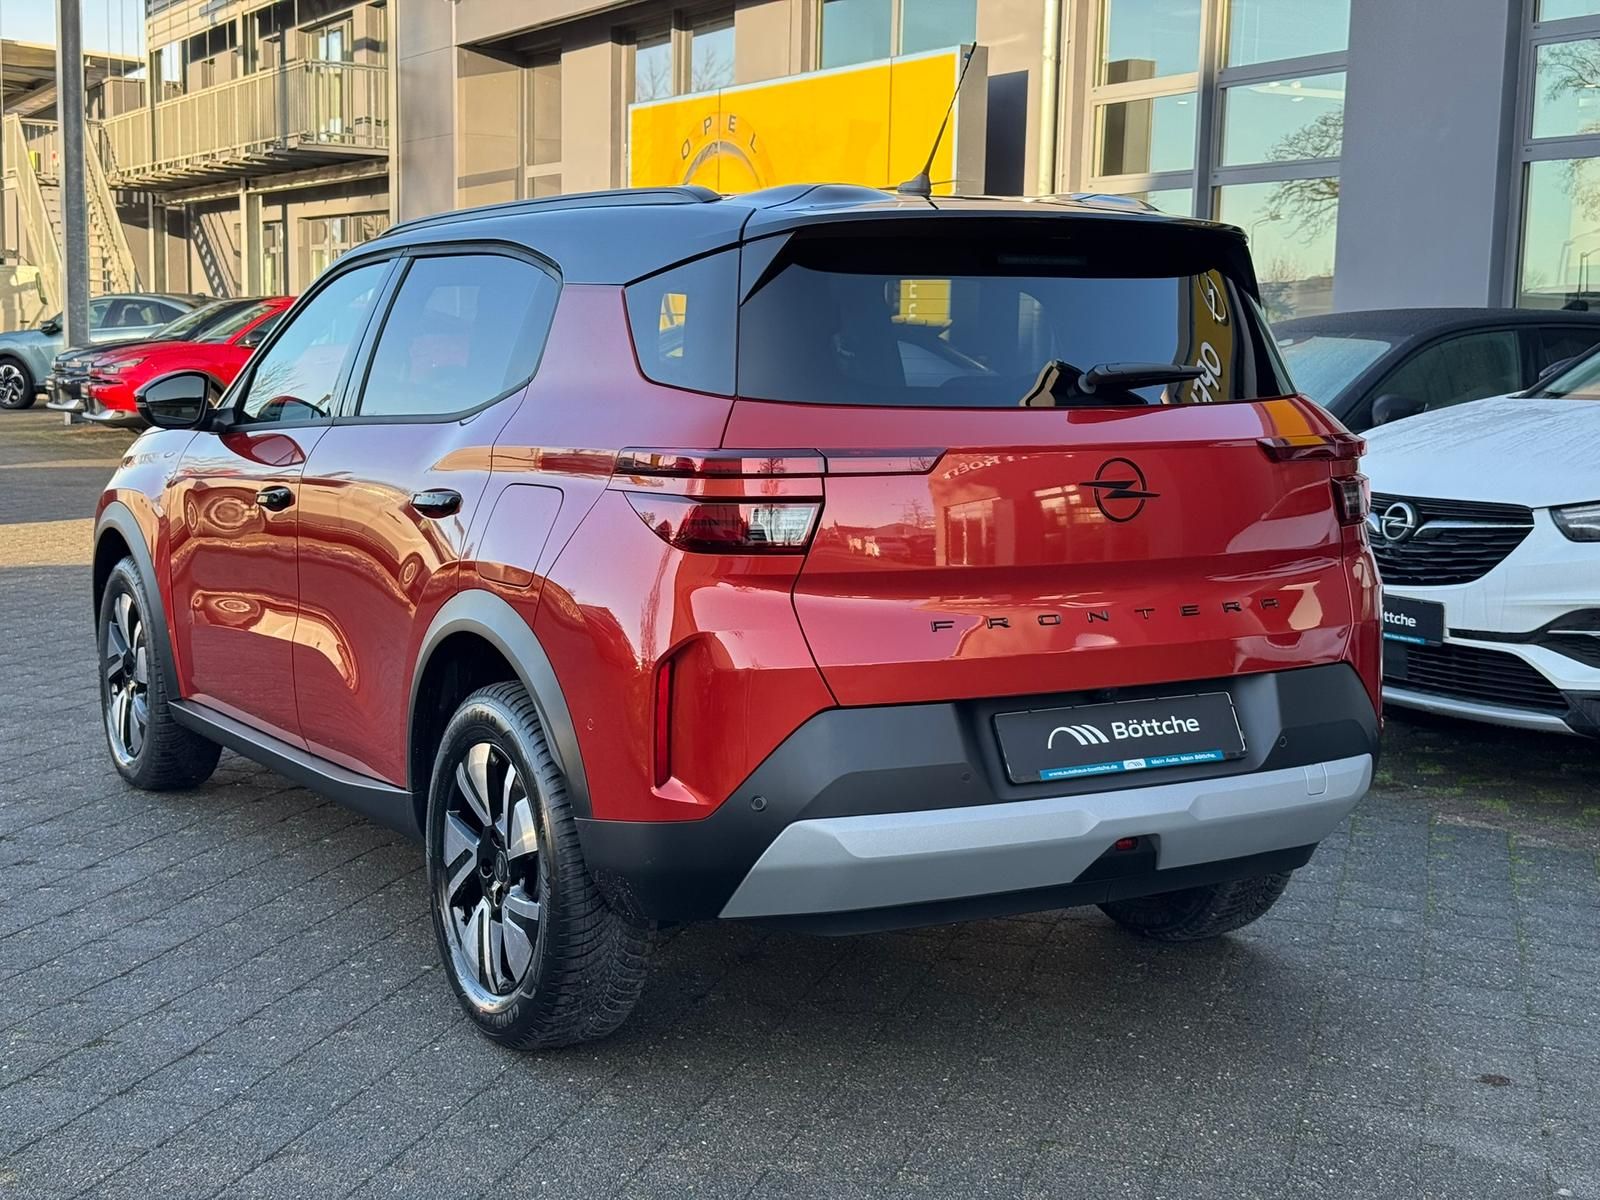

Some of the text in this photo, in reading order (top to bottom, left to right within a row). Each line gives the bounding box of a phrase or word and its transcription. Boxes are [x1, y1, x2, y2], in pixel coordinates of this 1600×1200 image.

[681, 114, 757, 160] OPEL
[930, 597, 1281, 633] FRONTERA
[1384, 611, 1417, 627] ttche
[1111, 715, 1201, 740] Böttche
